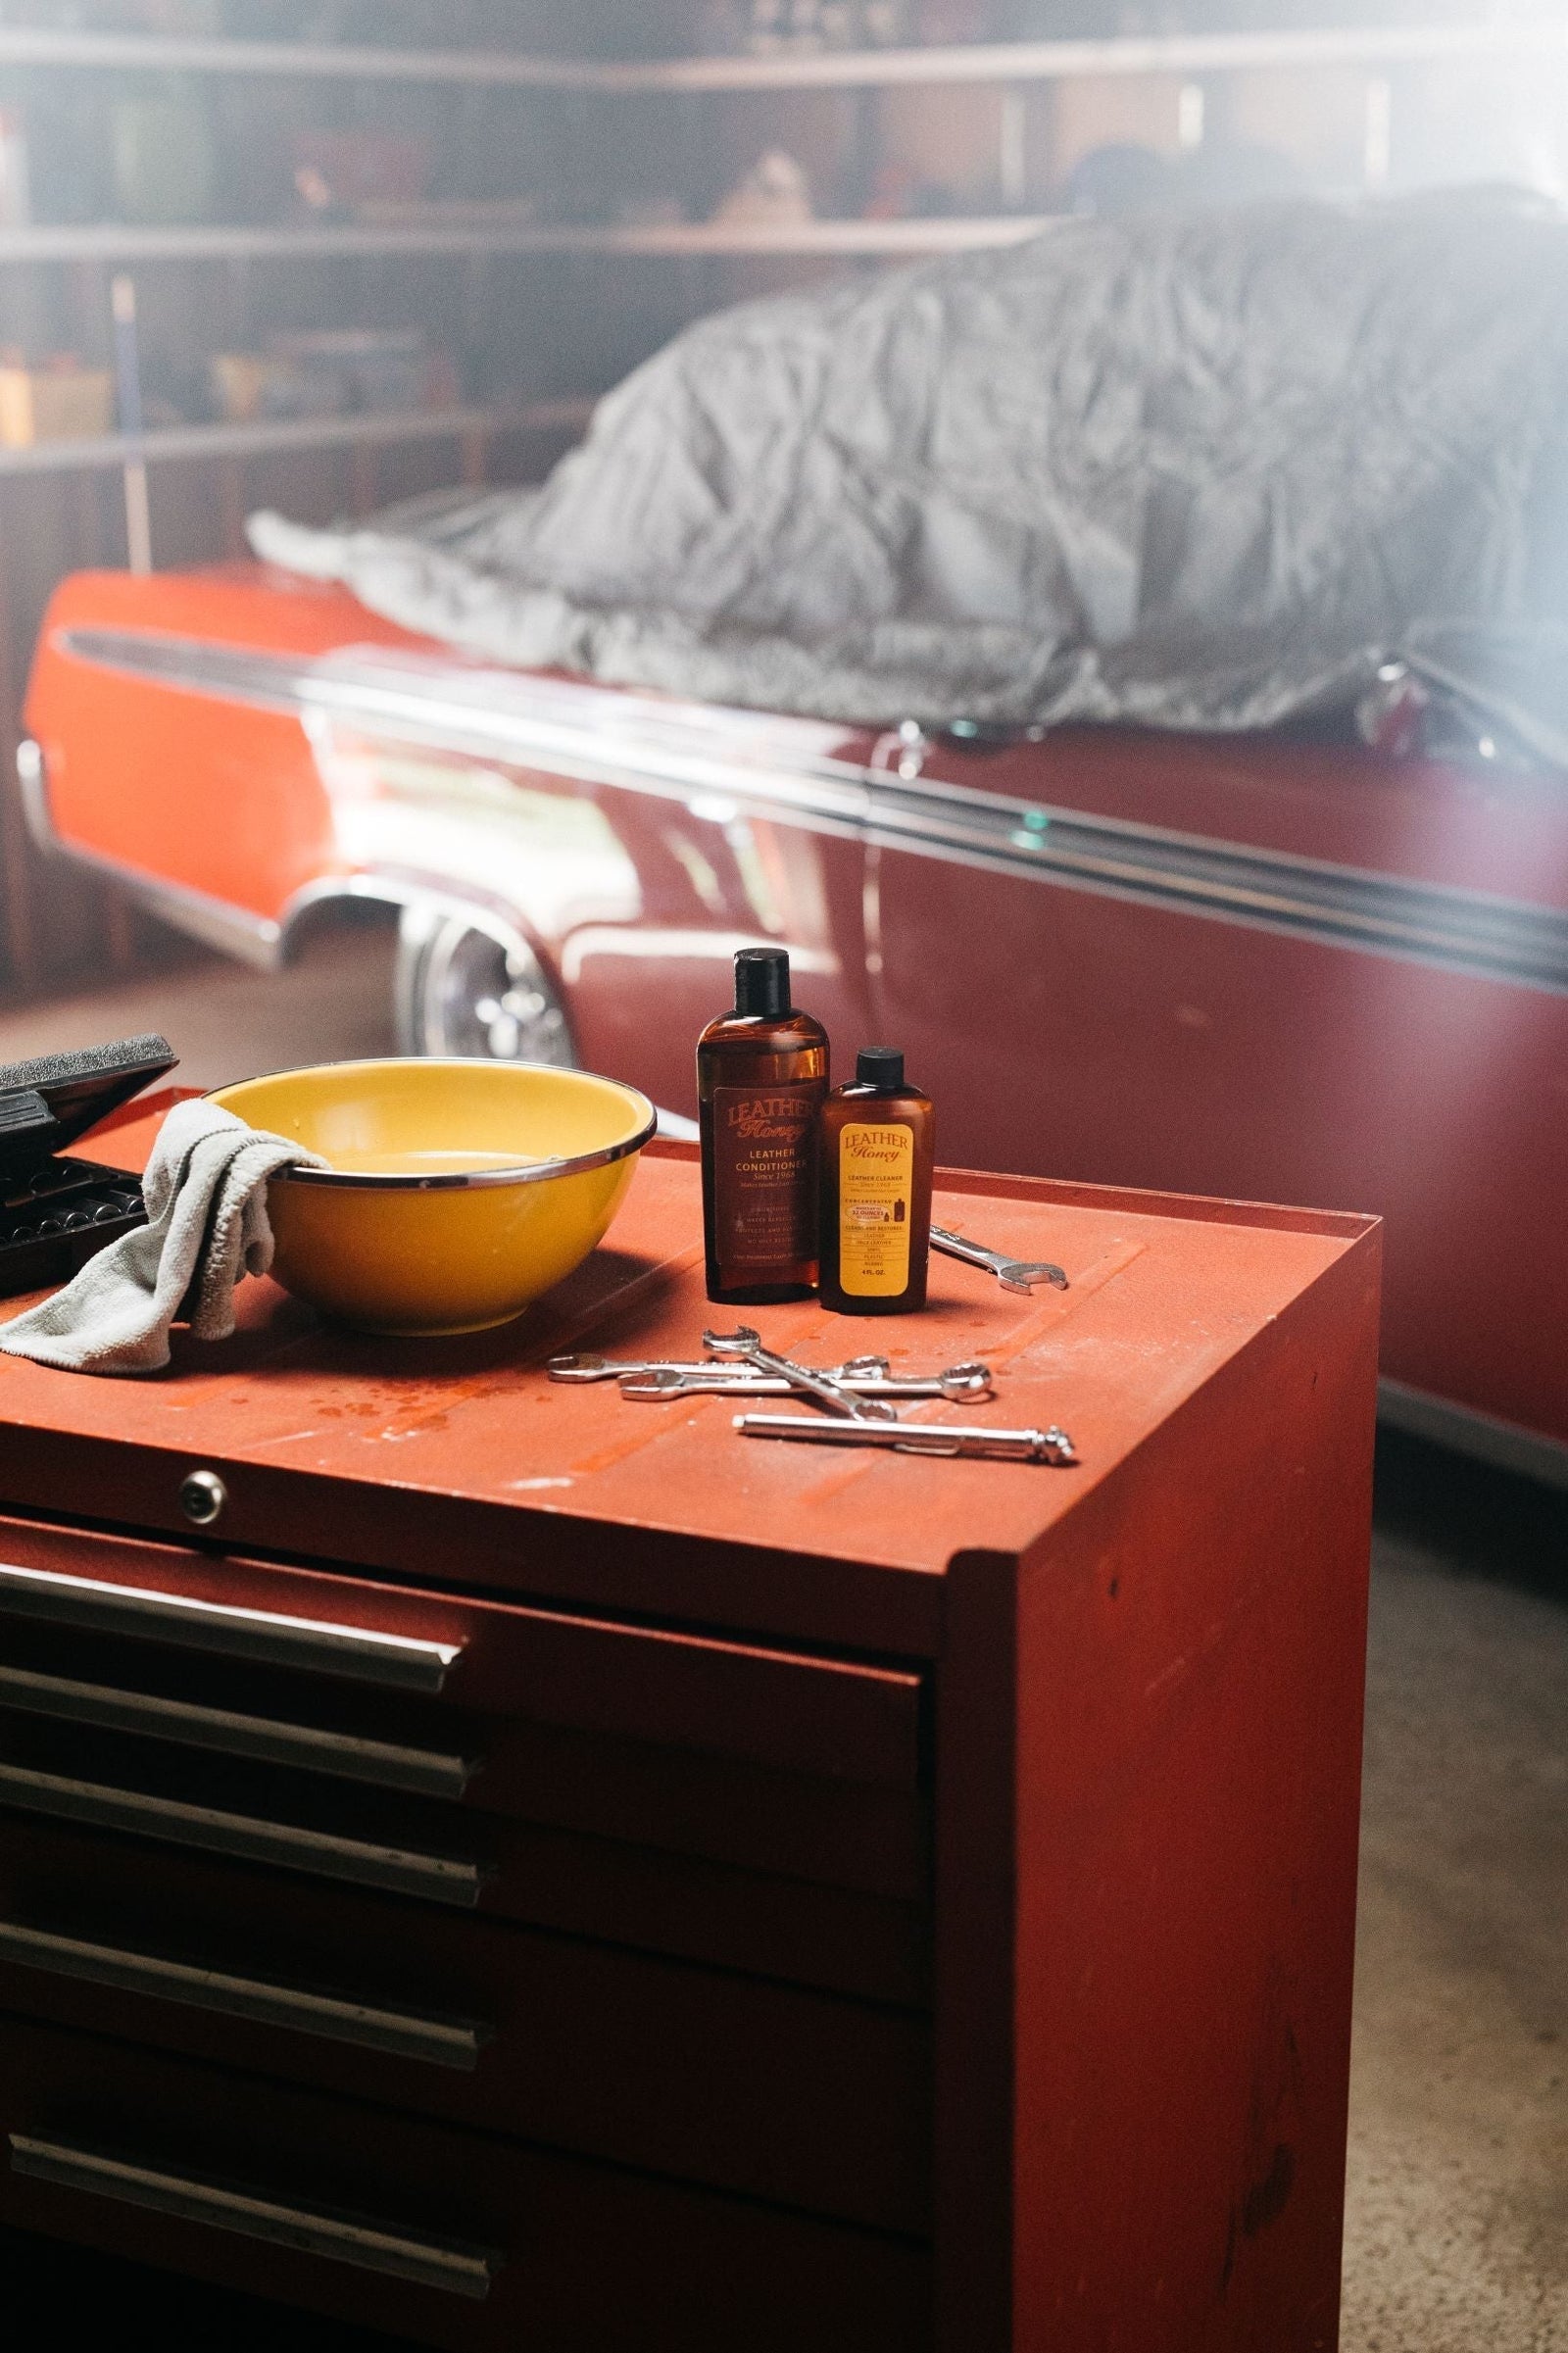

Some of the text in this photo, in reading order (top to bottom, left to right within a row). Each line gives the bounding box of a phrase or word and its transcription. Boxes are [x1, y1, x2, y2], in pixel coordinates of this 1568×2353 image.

[728, 1099, 814, 1126] LEATHER
[737, 1119, 805, 1143] Honey
[845, 1132, 907, 1150] LEATHER
[750, 1149, 795, 1158] LEATHER
[851, 1146, 900, 1163] Honey
[736, 1160, 808, 1171] CONDITIONER
